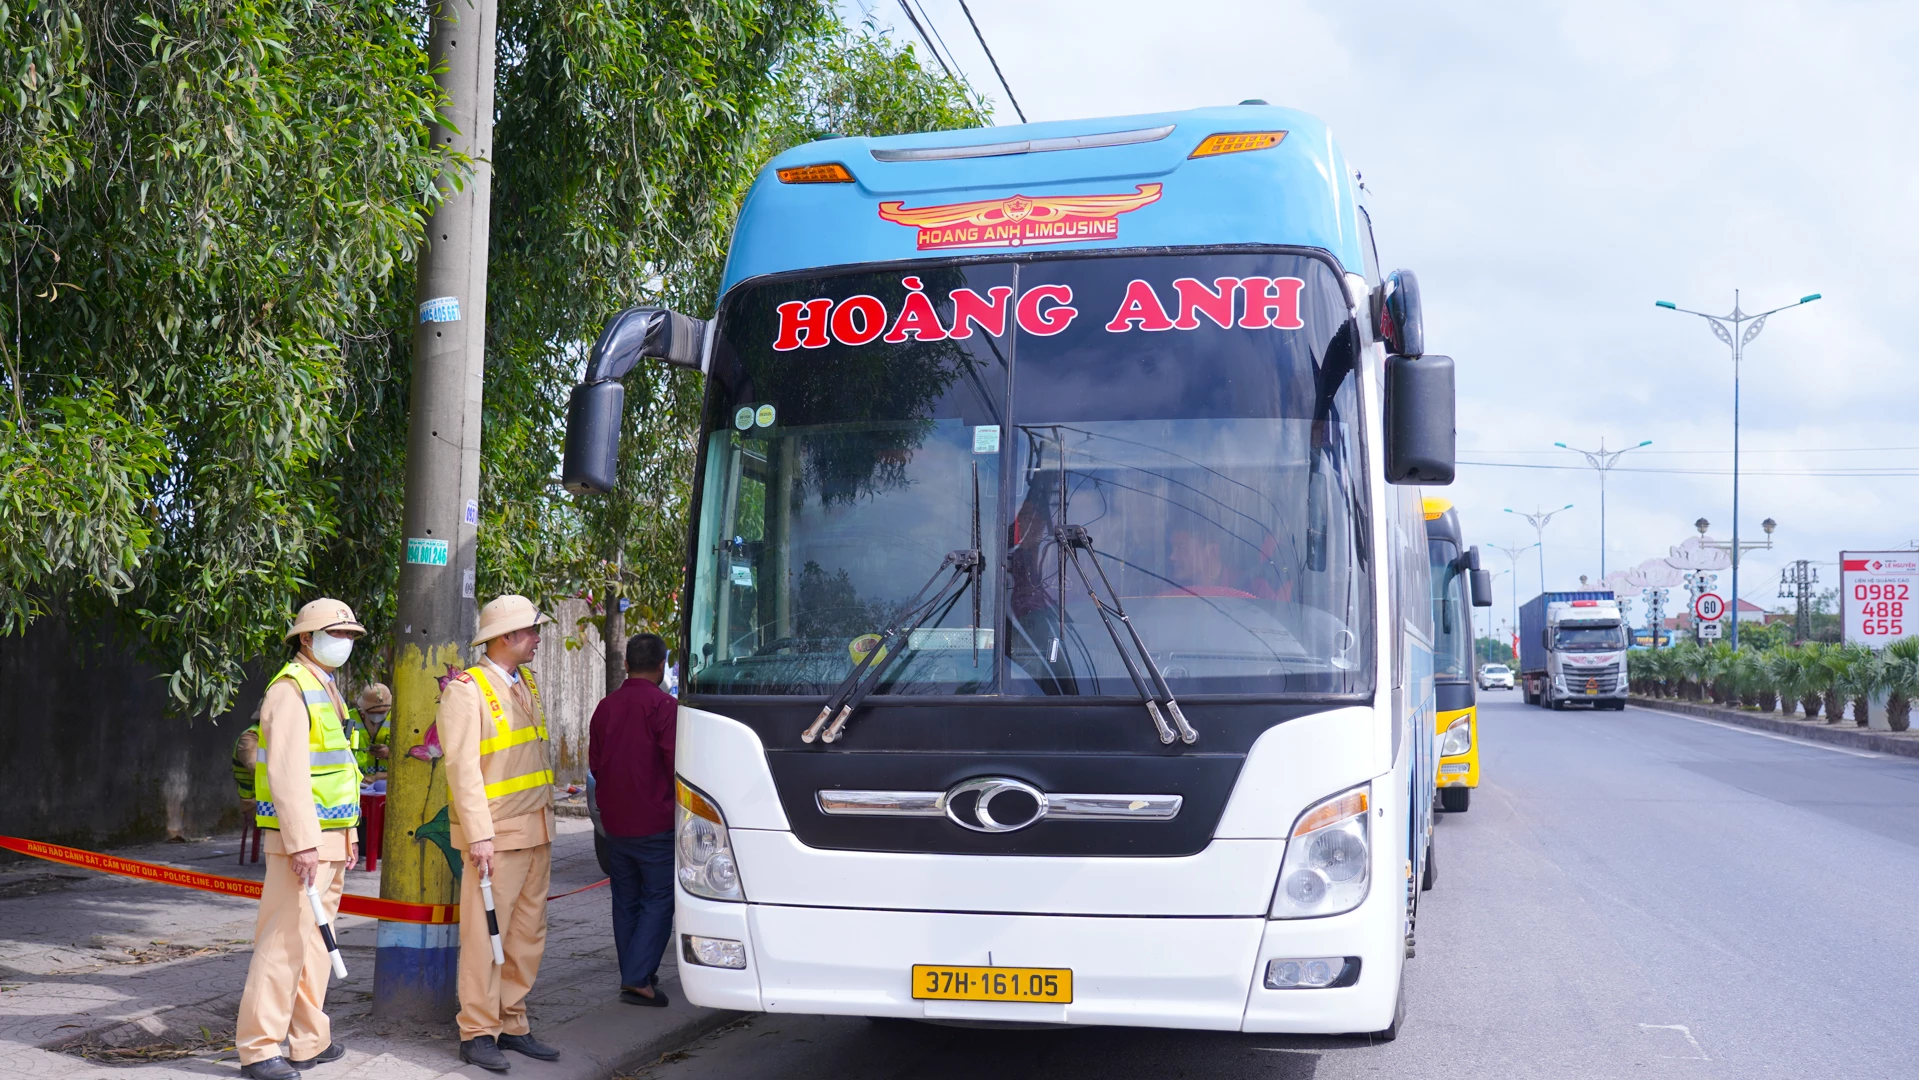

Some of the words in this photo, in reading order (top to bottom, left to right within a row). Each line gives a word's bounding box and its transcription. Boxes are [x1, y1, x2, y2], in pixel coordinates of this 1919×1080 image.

[919, 229, 979, 245] HOANG
[983, 224, 1021, 240] ANH
[1025, 218, 1118, 238] LIMOUSINE
[772, 276, 1079, 352] HOÀNG
[1105, 276, 1305, 334] ANH
[1854, 584, 1909, 600] 0982
[1704, 600, 1716, 614] 60
[1862, 601, 1903, 618] 488
[1862, 619, 1903, 635] 655
[141, 866, 158, 877] QUA
[163, 871, 191, 883] POLICE
[214, 880, 225, 889] DO
[226, 882, 242, 892] NOT
[926, 971, 1058, 997] 37H-161.05
